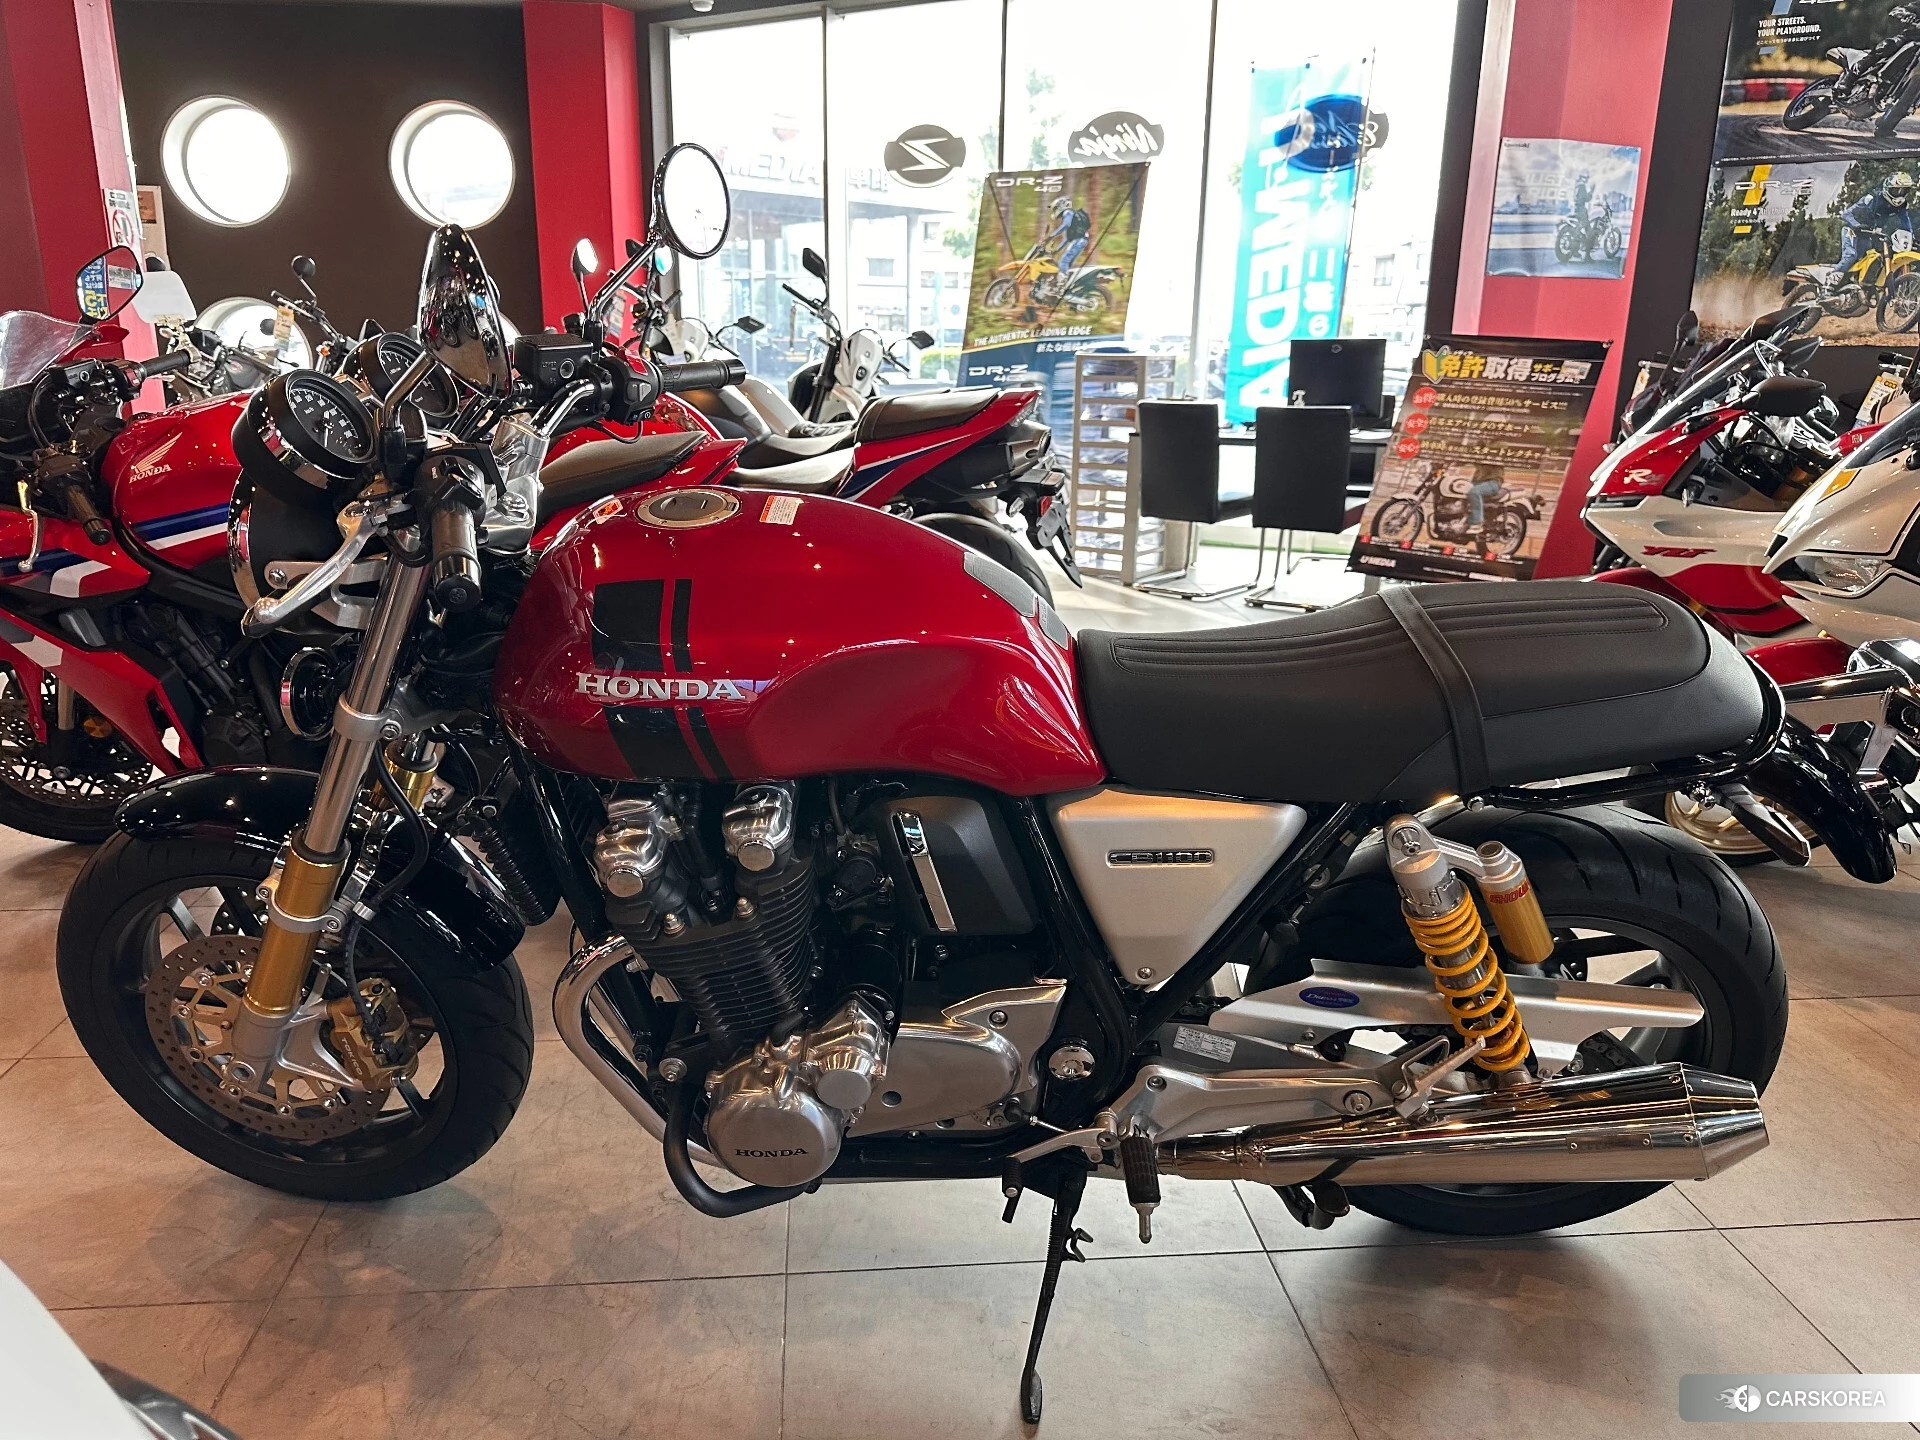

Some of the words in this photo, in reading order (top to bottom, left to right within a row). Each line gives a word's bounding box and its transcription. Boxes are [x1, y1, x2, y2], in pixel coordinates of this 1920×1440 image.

[1759, 19, 1776, 28] YOUR
[1777, 16, 1806, 26] STREETS.
[1757, 28, 1775, 37] YOUR
[1775, 24, 1821, 35] PLAYGROUND.
[1731, 208, 1751, 217] Ready
[974, 336, 988, 347] THE
[988, 329, 1030, 344] AUTHENTIC
[1030, 326, 1067, 338] LEADING
[1068, 325, 1092, 335] EDGE
[1441, 353, 1533, 382] 免許取得
[129, 464, 172, 484] HONDA
[574, 672, 746, 700] HONDA
[1110, 851, 1213, 864] CB1100
[341, 1037, 363, 1076] TOKICO
[734, 1148, 809, 1158] HONDA
